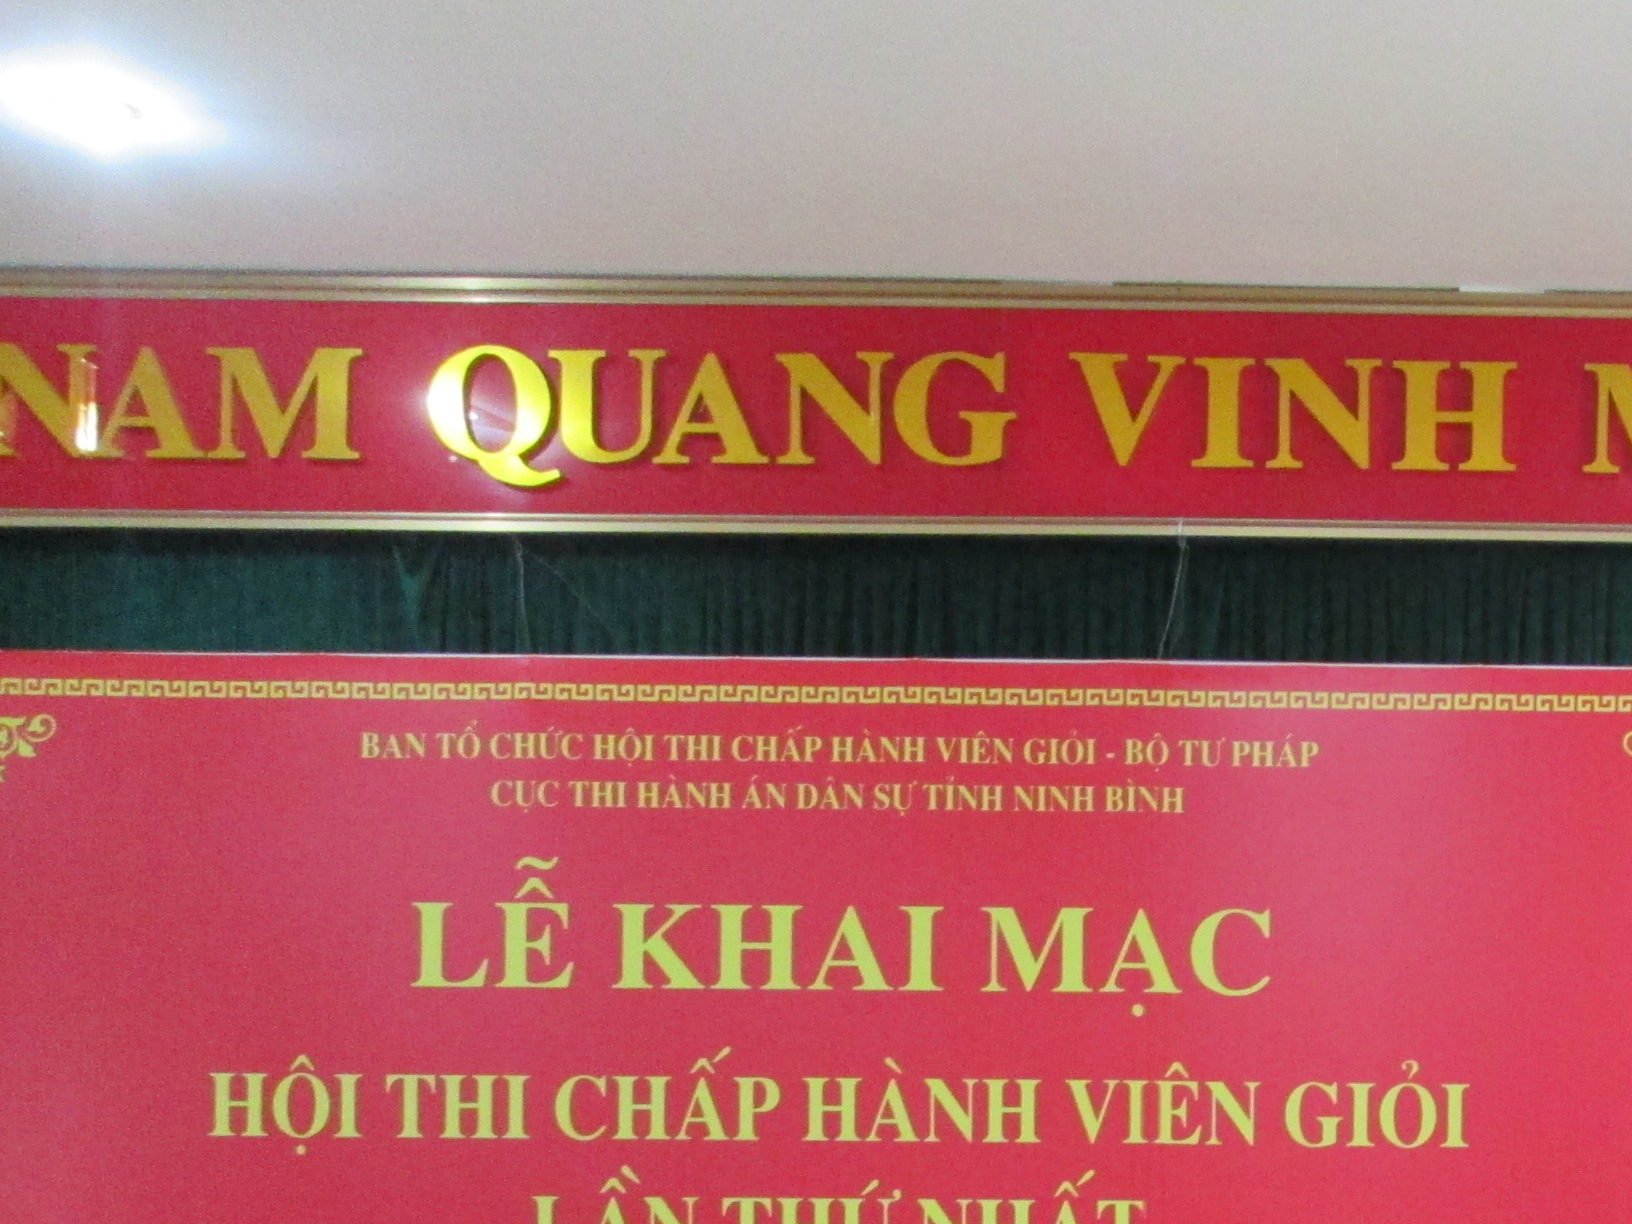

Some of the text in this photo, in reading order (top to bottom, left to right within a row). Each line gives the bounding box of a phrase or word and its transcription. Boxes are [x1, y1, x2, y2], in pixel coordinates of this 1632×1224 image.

[0, 341, 363, 461] NAM
[424, 343, 1016, 489] QUANG
[1070, 351, 1518, 475] VINH
[359, 731, 427, 760] BAN
[436, 720, 481, 760] TỔ
[489, 727, 584, 761] CHỨC
[592, 727, 656, 767] HỘI
[663, 734, 722, 763] THI
[730, 725, 821, 764] CHẤP
[829, 728, 927, 765] HÀNH
[935, 730, 1015, 765] VIÊN
[1022, 730, 1098, 766] GIỎI
[1124, 733, 1171, 771] BỘ
[1179, 738, 1226, 767] TƯ
[1232, 733, 1321, 769] PHÁP
[489, 774, 1185, 817] CỤC THI HÀNH ÁN DÂN SỰ TỈNH NINH BÌNH
[413, 856, 1272, 1017] LỄ KHAI MẠC
[210, 1045, 1468, 1155] HỘI THI CHẤP HÀNH VIÊN GIỎI
